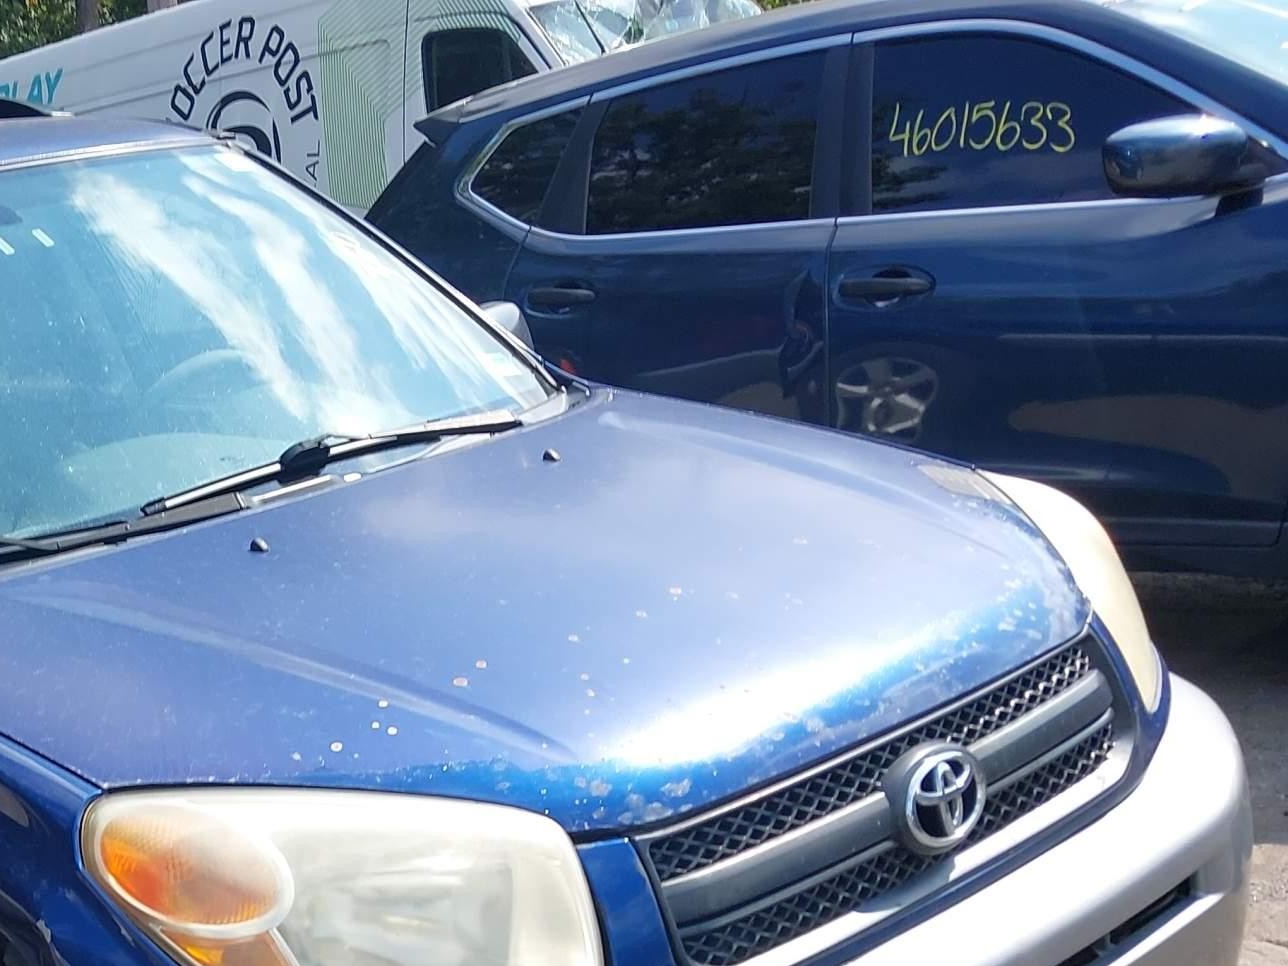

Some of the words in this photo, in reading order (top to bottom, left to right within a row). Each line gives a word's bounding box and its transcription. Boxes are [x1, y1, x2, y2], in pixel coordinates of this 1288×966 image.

[167, 16, 255, 121] OCCER
[258, 24, 319, 124] POST
[889, 101, 1076, 158] 46015633
